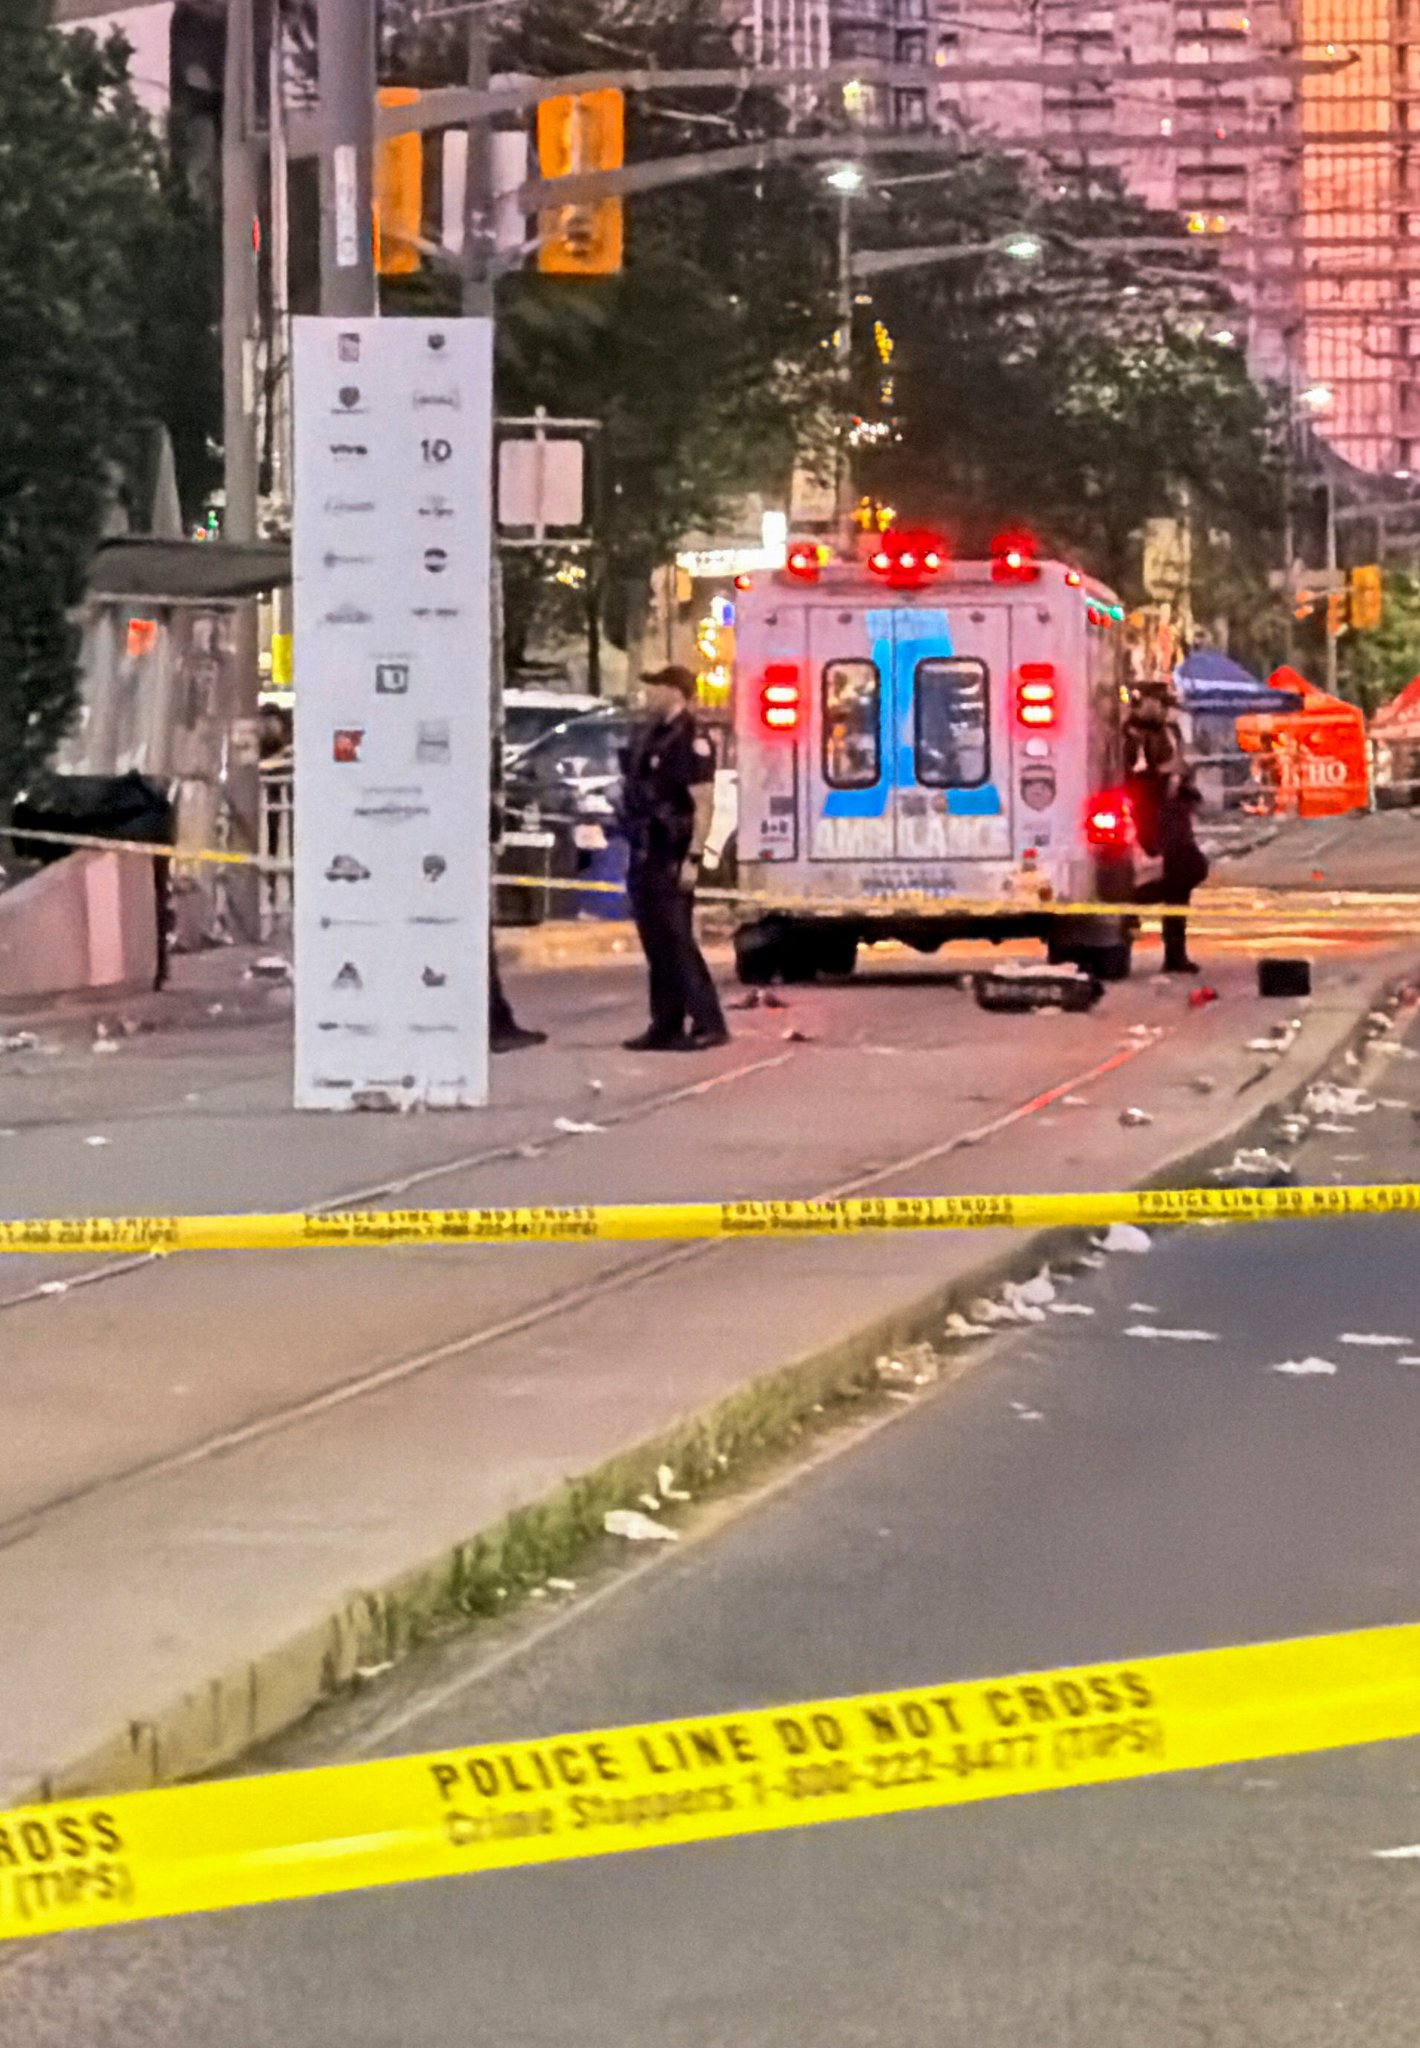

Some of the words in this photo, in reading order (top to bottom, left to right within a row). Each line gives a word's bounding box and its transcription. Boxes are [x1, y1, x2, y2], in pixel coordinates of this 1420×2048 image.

[421, 439, 452, 463] 10
[429, 1741, 620, 1802] POLICE
[636, 1724, 759, 1774] LINE
[772, 1713, 845, 1756] DO
[862, 1696, 963, 1744] NOT
[982, 1670, 1155, 1728] CROSS
